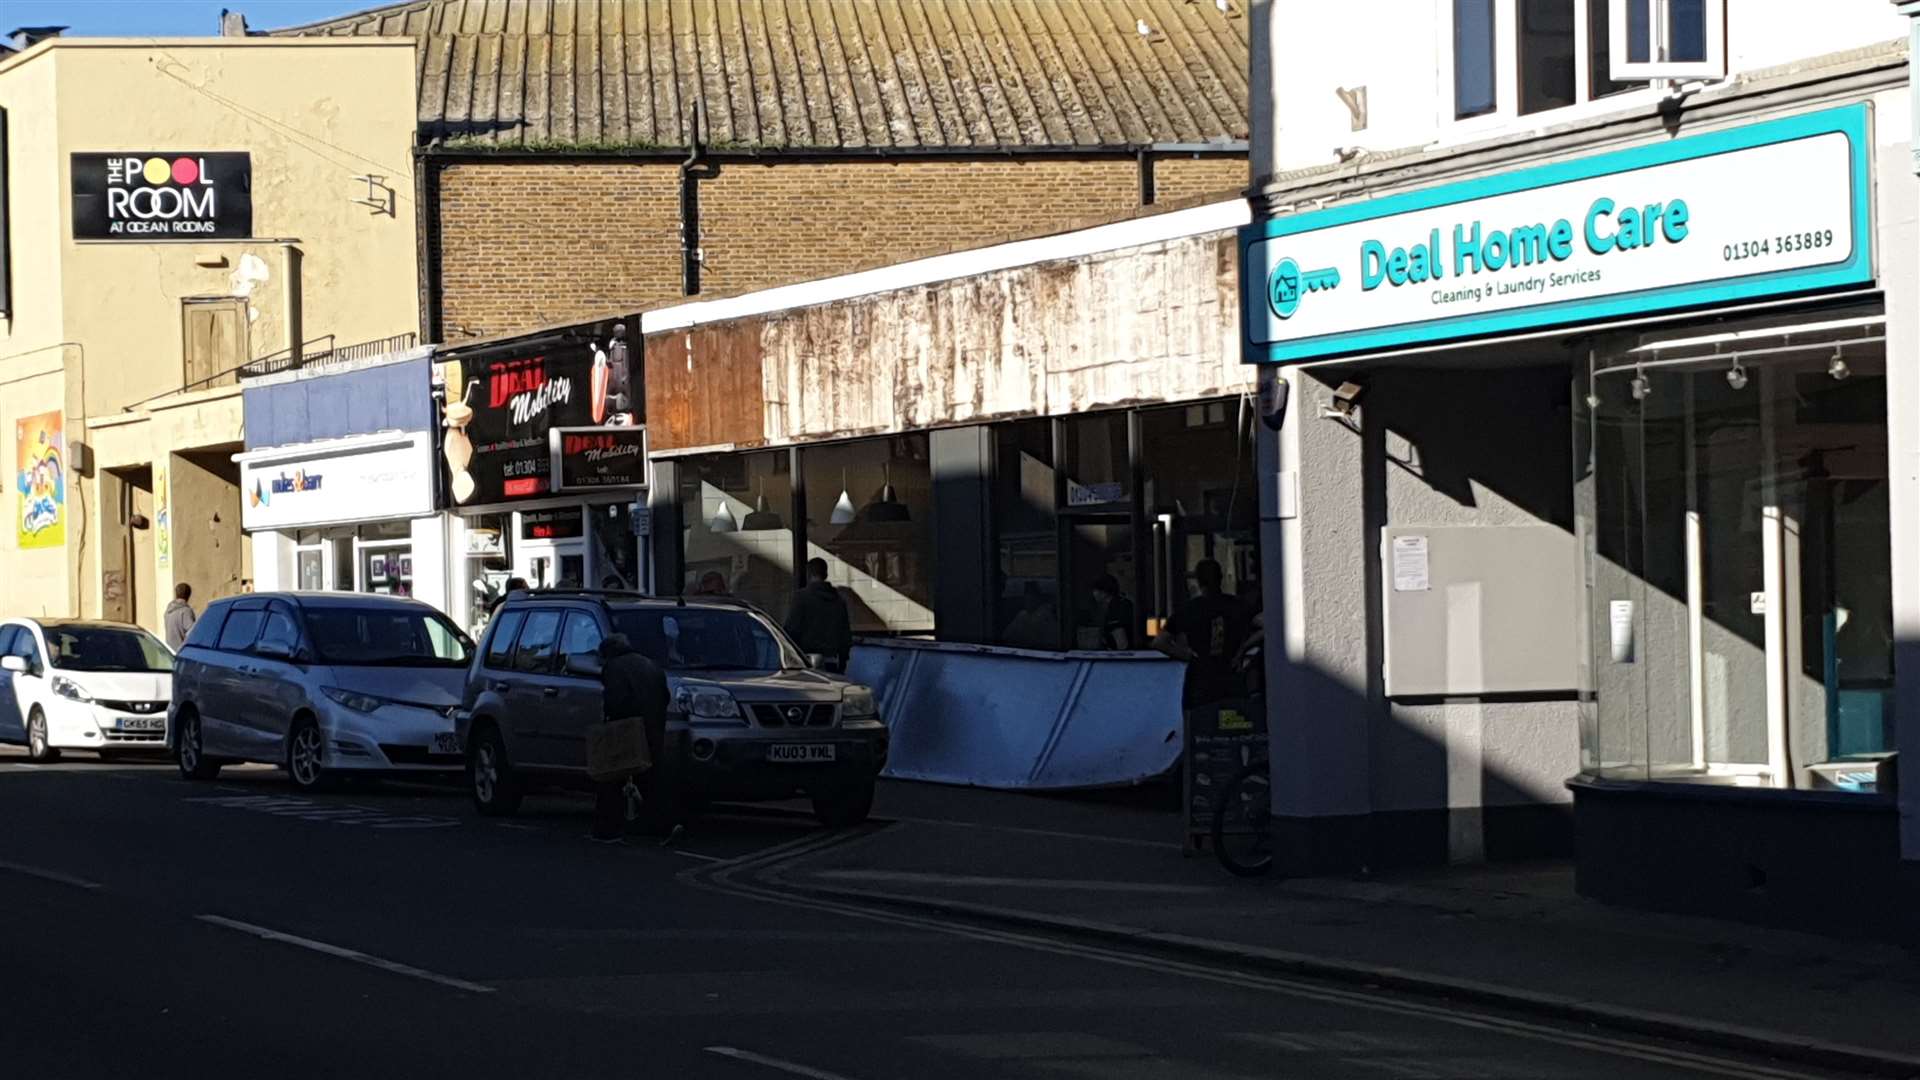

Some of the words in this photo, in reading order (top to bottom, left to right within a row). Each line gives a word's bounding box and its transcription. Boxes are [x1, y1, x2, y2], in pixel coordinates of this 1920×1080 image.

[107, 158, 123, 185] THE
[107, 186, 215, 219] ROOM
[110, 221, 124, 233] AT
[126, 221, 169, 233] OCEAN
[172, 221, 216, 233] ROOMS
[1360, 227, 1443, 292] Deal
[1453, 218, 1574, 278] Home
[1584, 197, 1690, 255] Care
[1722, 239, 1770, 261] 01304
[1774, 229, 1834, 255] 363889
[1431, 281, 1482, 305] Cleaning
[1484, 283, 1493, 299] &
[1496, 275, 1545, 297] Laundry
[1549, 268, 1601, 289] Services
[510, 376, 571, 425] Mobility
[774, 746, 807, 759] KU03
